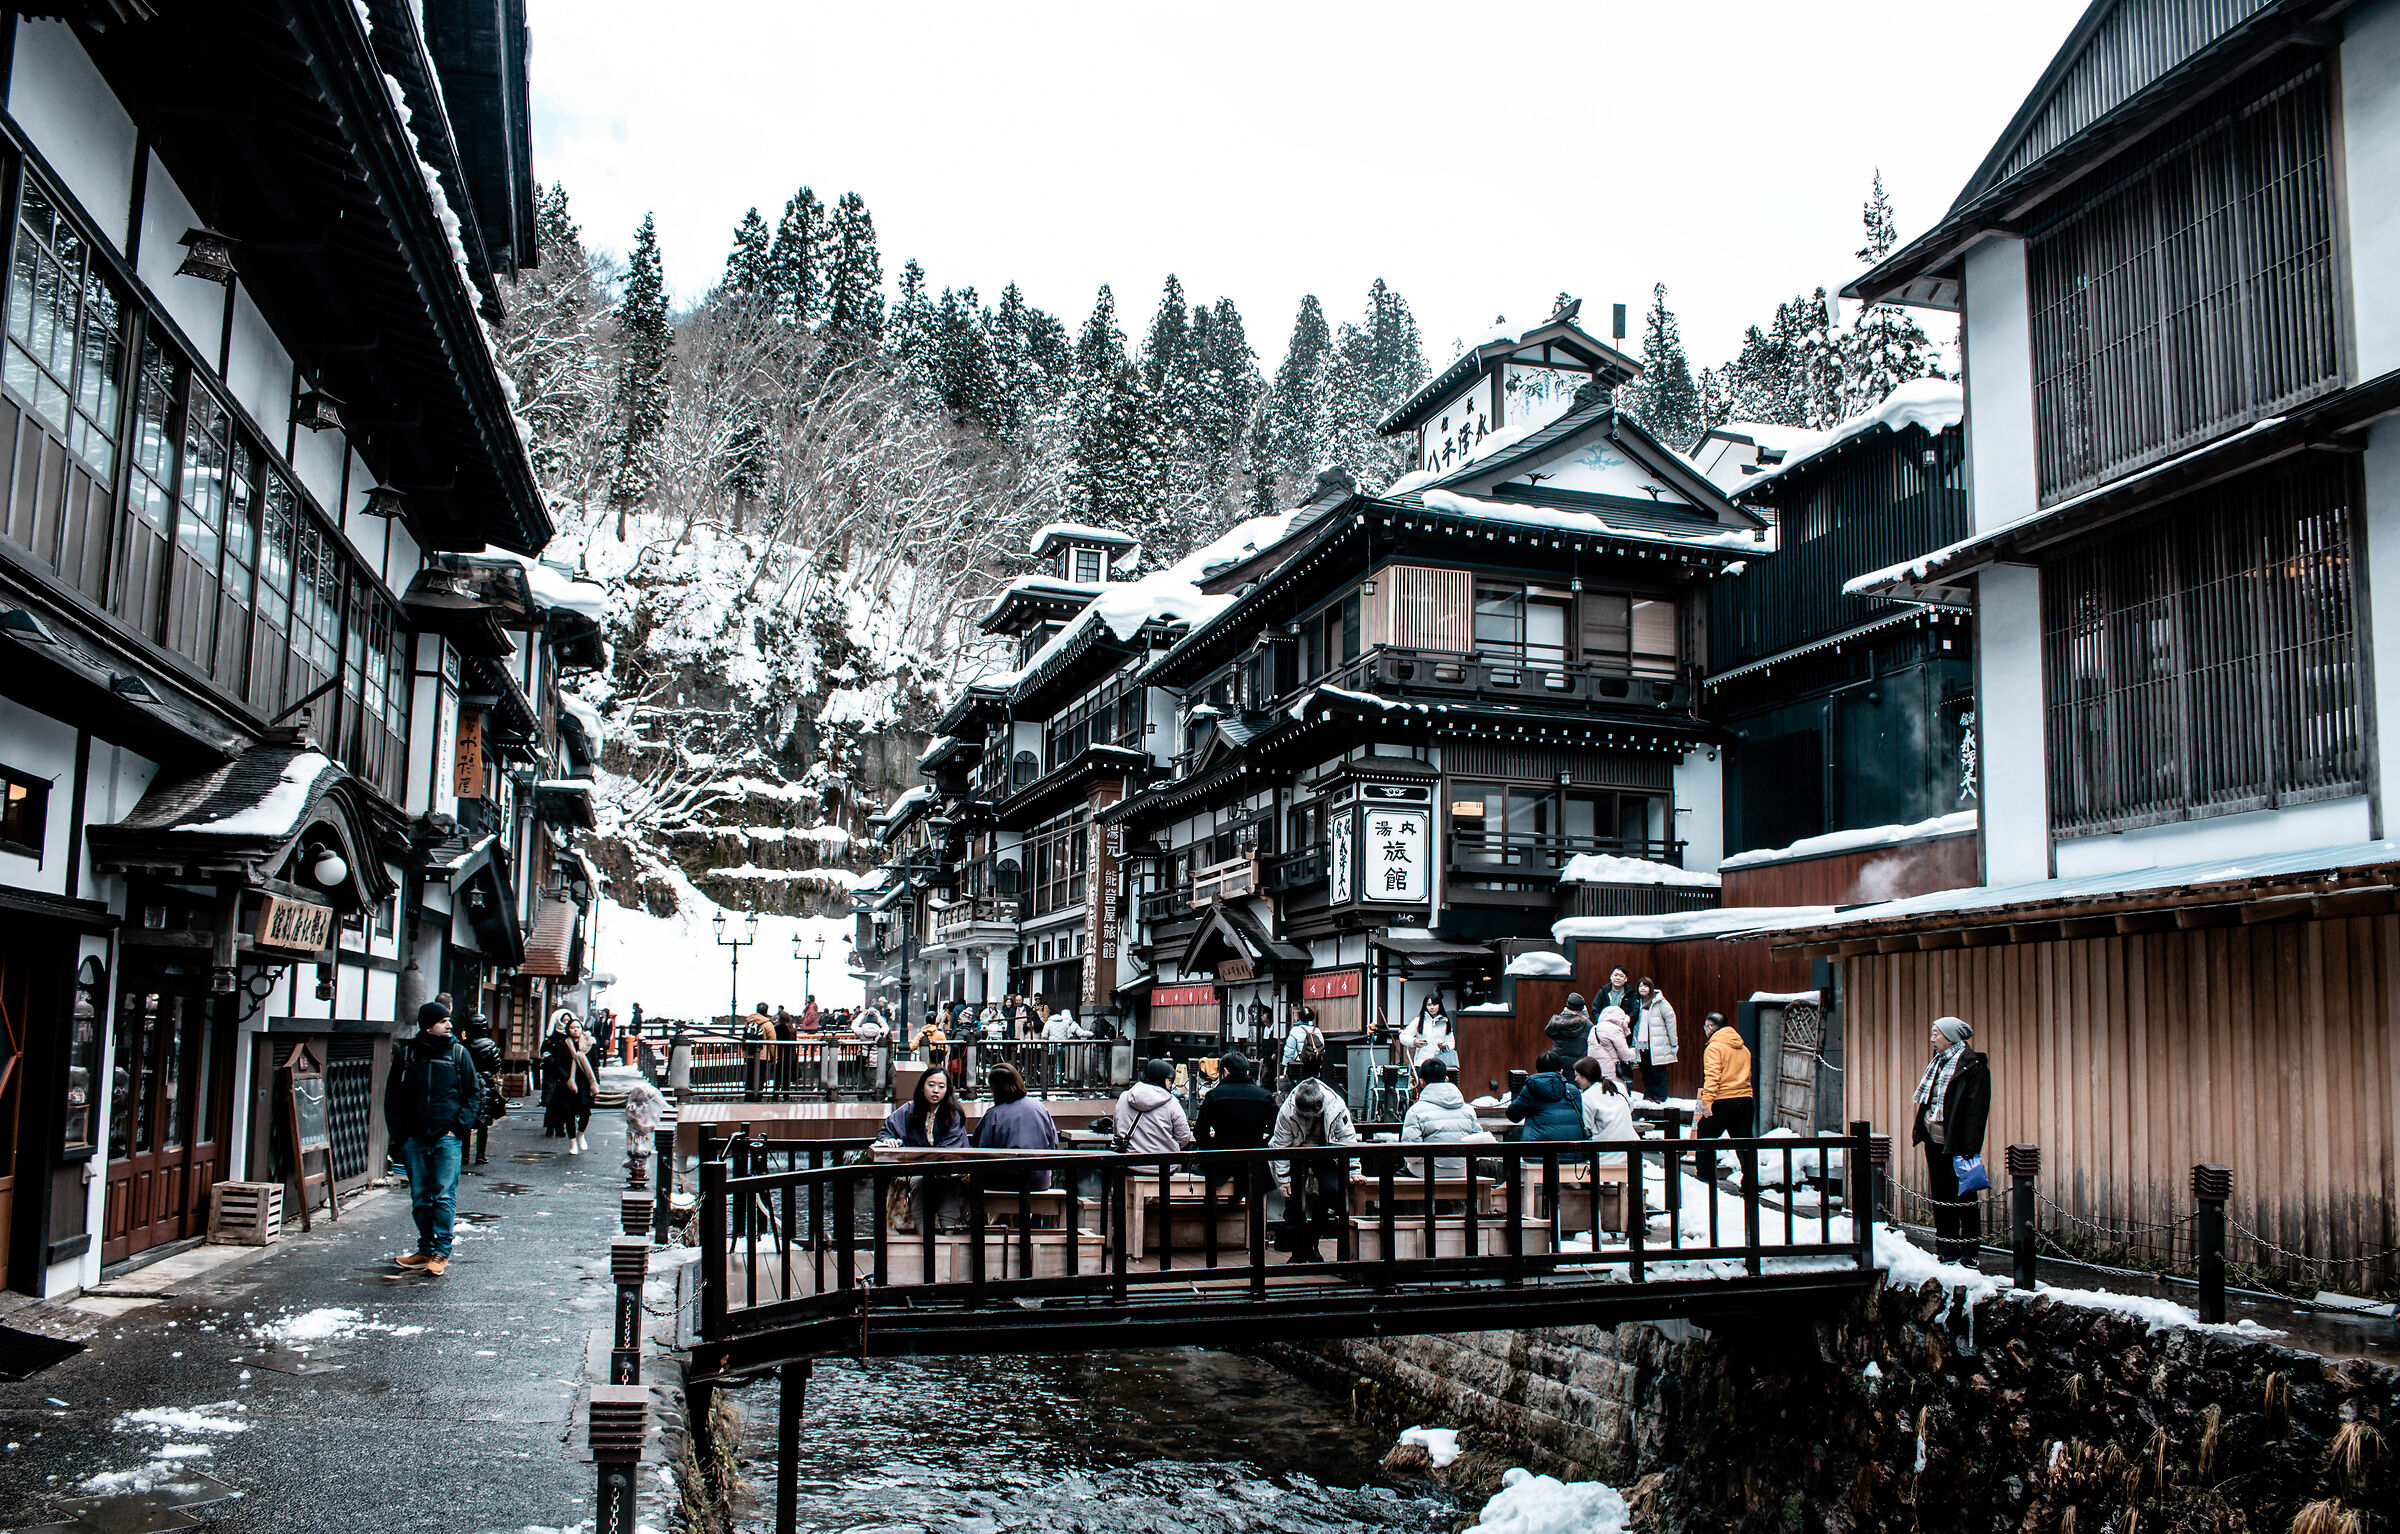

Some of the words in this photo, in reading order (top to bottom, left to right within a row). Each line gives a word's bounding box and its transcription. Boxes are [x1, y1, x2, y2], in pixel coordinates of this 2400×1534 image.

[1382, 840, 1412, 892] 旅館
[1102, 869, 1118, 960] 能登屋旅館
